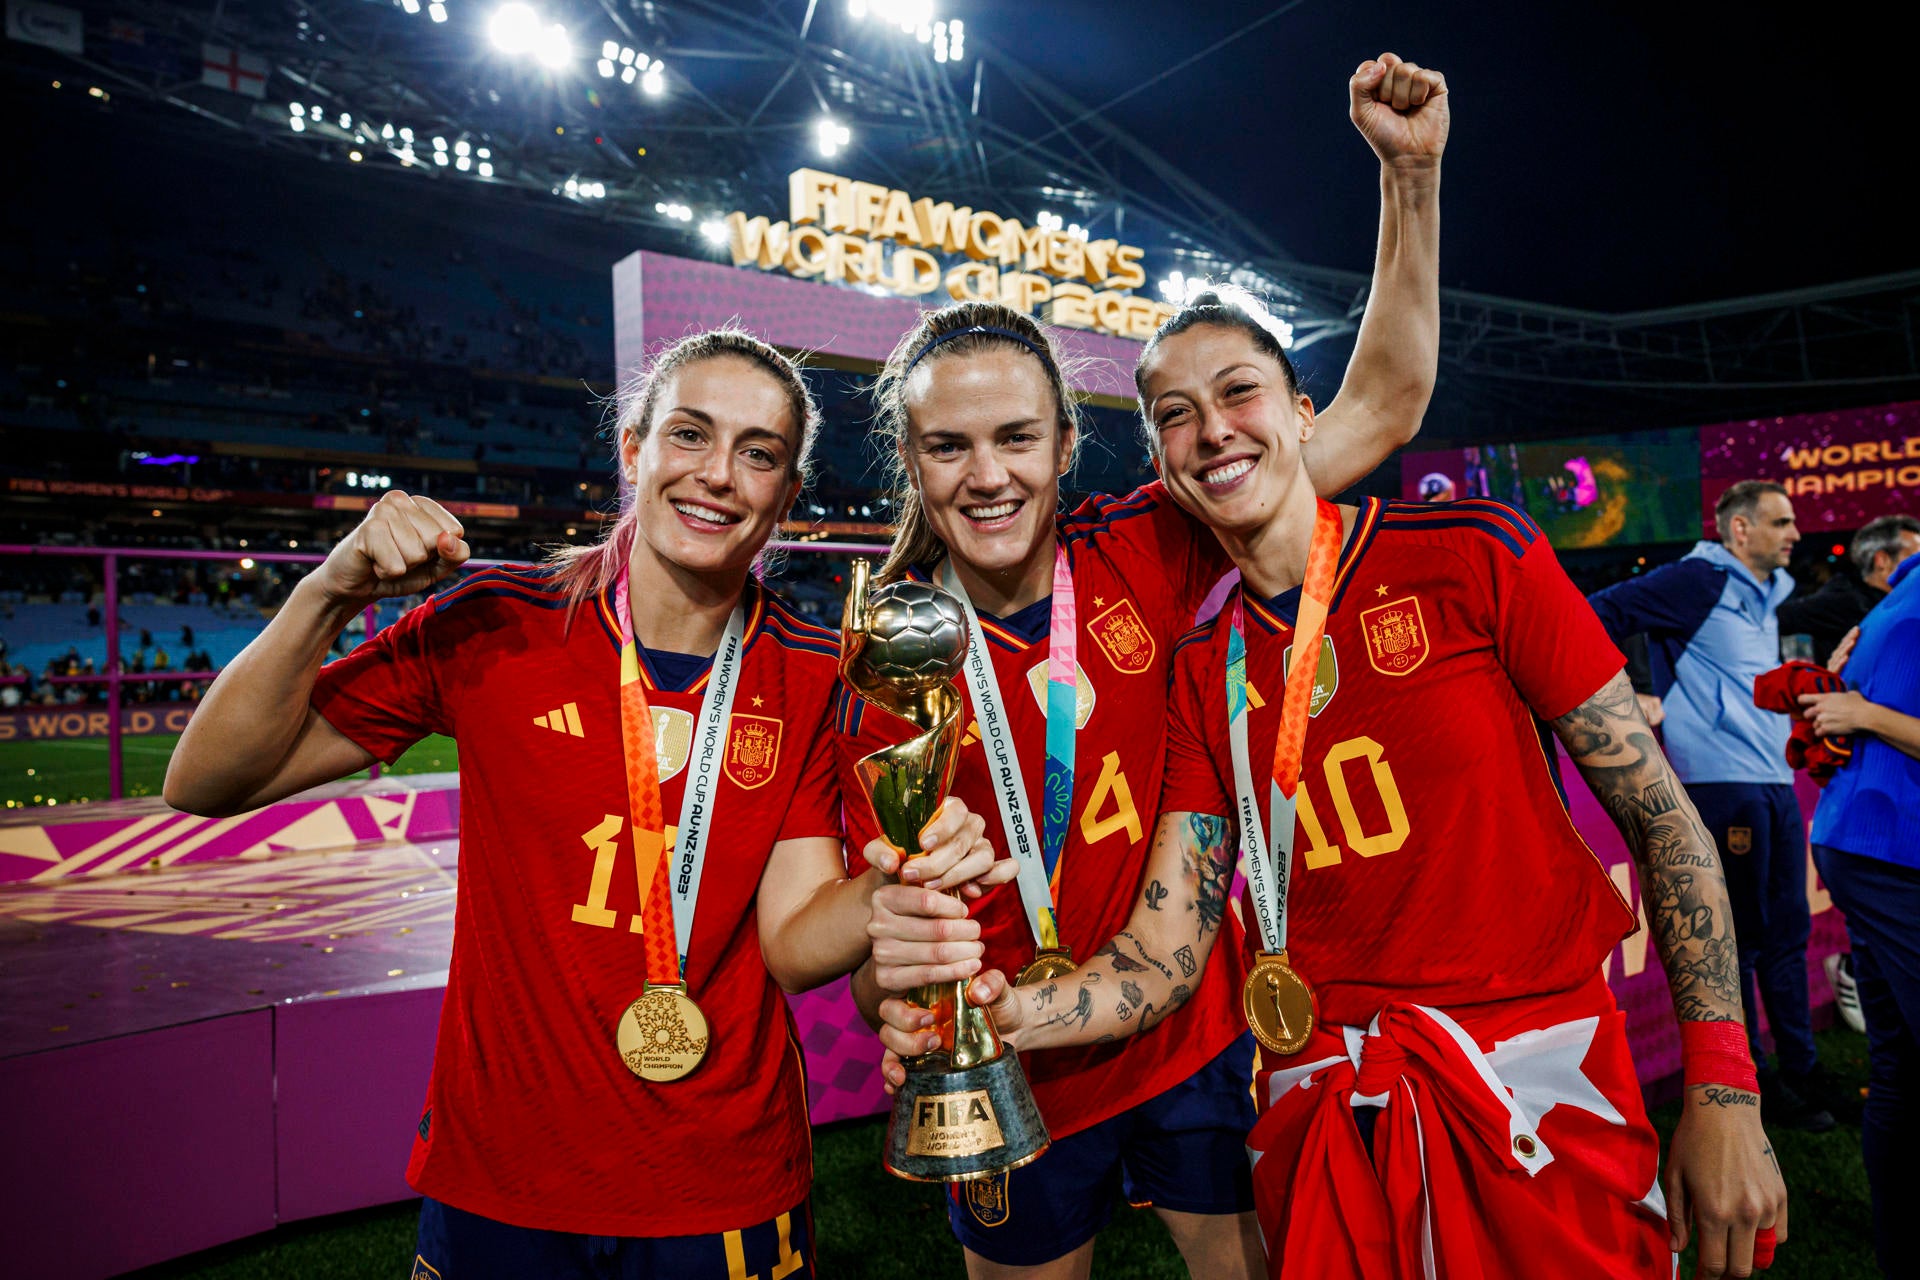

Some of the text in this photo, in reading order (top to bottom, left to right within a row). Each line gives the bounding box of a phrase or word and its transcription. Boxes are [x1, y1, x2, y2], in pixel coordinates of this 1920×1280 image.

[789, 167, 1146, 290] FIFA WOMEN'S
[729, 211, 940, 296] WORLD
[945, 261, 1053, 314] CUP
[722, 635, 738, 663] FIFA
[710, 663, 735, 724] WOMEN'S
[981, 689, 1002, 740] WORLD
[700, 724, 719, 774] WORLD
[991, 739, 1009, 766] CUP
[693, 774, 711, 803] CUP
[1079, 750, 1144, 845] 4
[1241, 796, 1253, 827] FIFA
[1246, 826, 1265, 893] WOMEN'S
[1257, 892, 1278, 946] WORLD
[918, 1097, 990, 1127] FIFA
[1699, 1088, 1757, 1108] Karma
